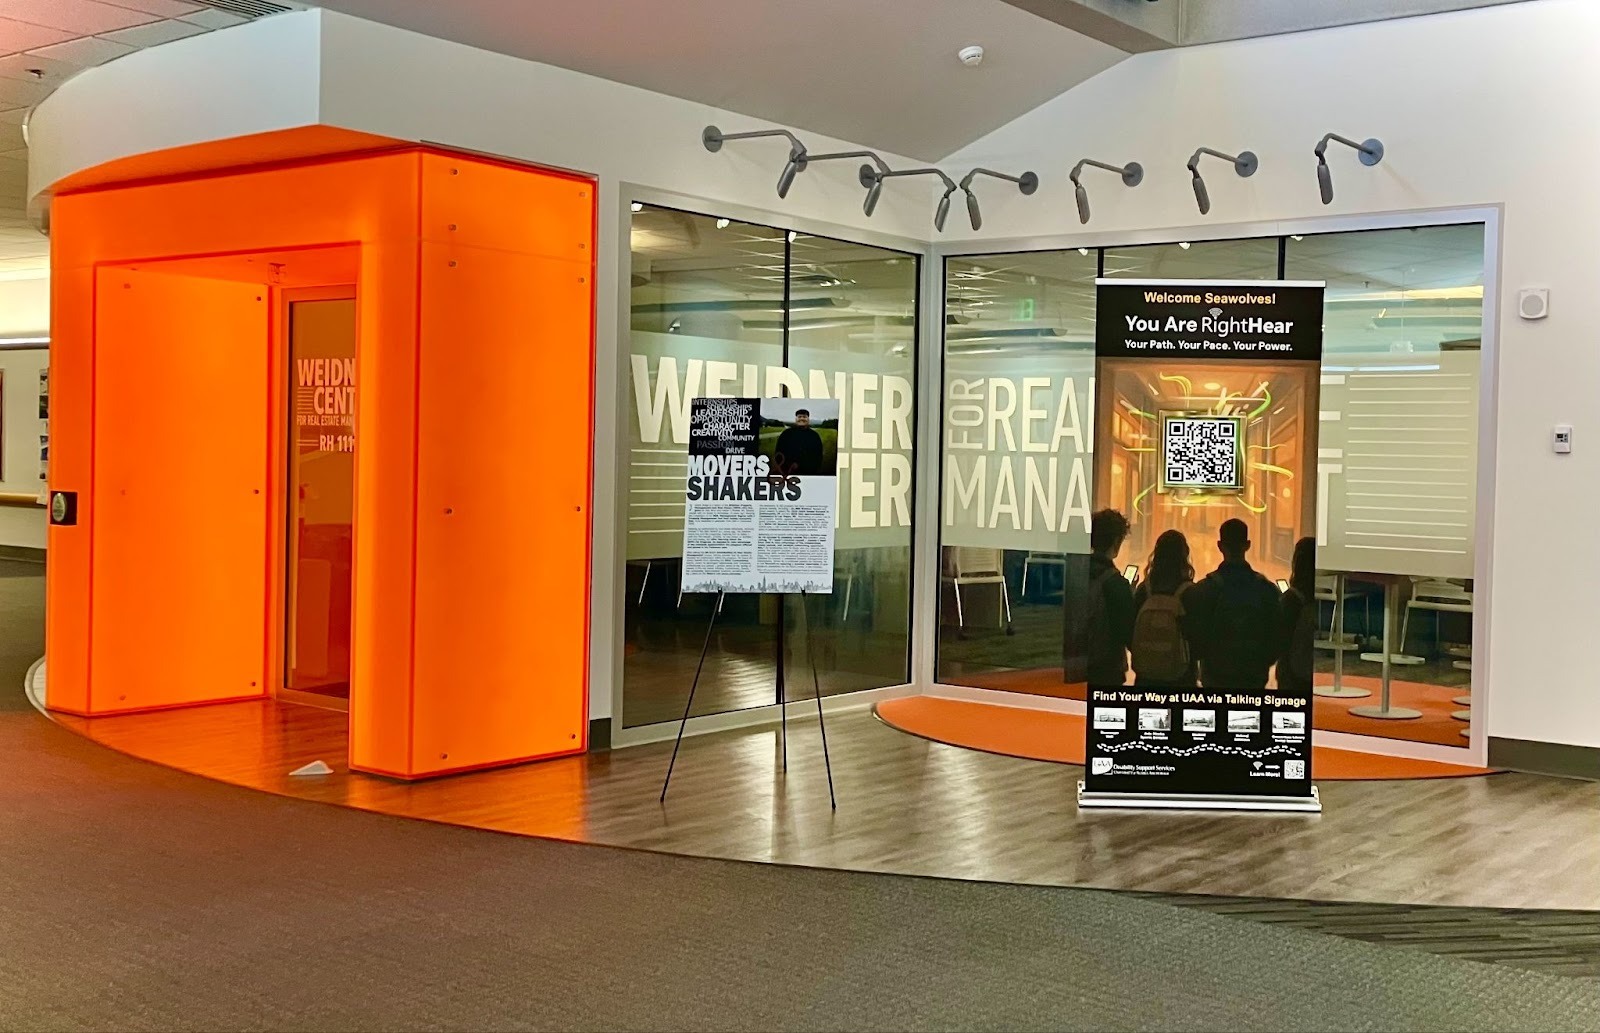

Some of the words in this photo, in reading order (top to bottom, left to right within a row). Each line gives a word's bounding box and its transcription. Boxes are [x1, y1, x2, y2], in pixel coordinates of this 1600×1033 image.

[1144, 291, 1201, 304] Welcome
[1205, 292, 1276, 305] Seawolves!
[1125, 315, 1160, 332] You
[1164, 316, 1198, 332] Are
[1201, 316, 1294, 337] RightHear
[1124, 339, 1149, 349] Your
[1149, 339, 1176, 350] Path.
[1178, 340, 1201, 350] Your
[1203, 341, 1231, 350] Pace.
[1233, 341, 1257, 351] Your
[1258, 341, 1293, 352] Power.
[690, 415, 752, 424] OPPORTUNITY
[695, 409, 748, 417] LEADERSHIP
[948, 378, 984, 450] FOR
[691, 429, 735, 437] CREATIVITY
[703, 423, 750, 431] CHARACTER
[320, 434, 334, 451] RH
[337, 435, 354, 452] 111
[696, 440, 735, 449] PASSION
[725, 446, 745, 454] DRIVE
[688, 454, 770, 477] MOVERS
[687, 476, 802, 501] SHAKERS
[1093, 690, 1117, 701] Find
[1118, 691, 1143, 702] Your
[1144, 692, 1167, 704] Way
[1168, 694, 1180, 703] at
[1181, 693, 1205, 704] UAA
[1206, 693, 1223, 704] via
[1225, 693, 1262, 707] Talking
[1264, 695, 1307, 708] Signage
